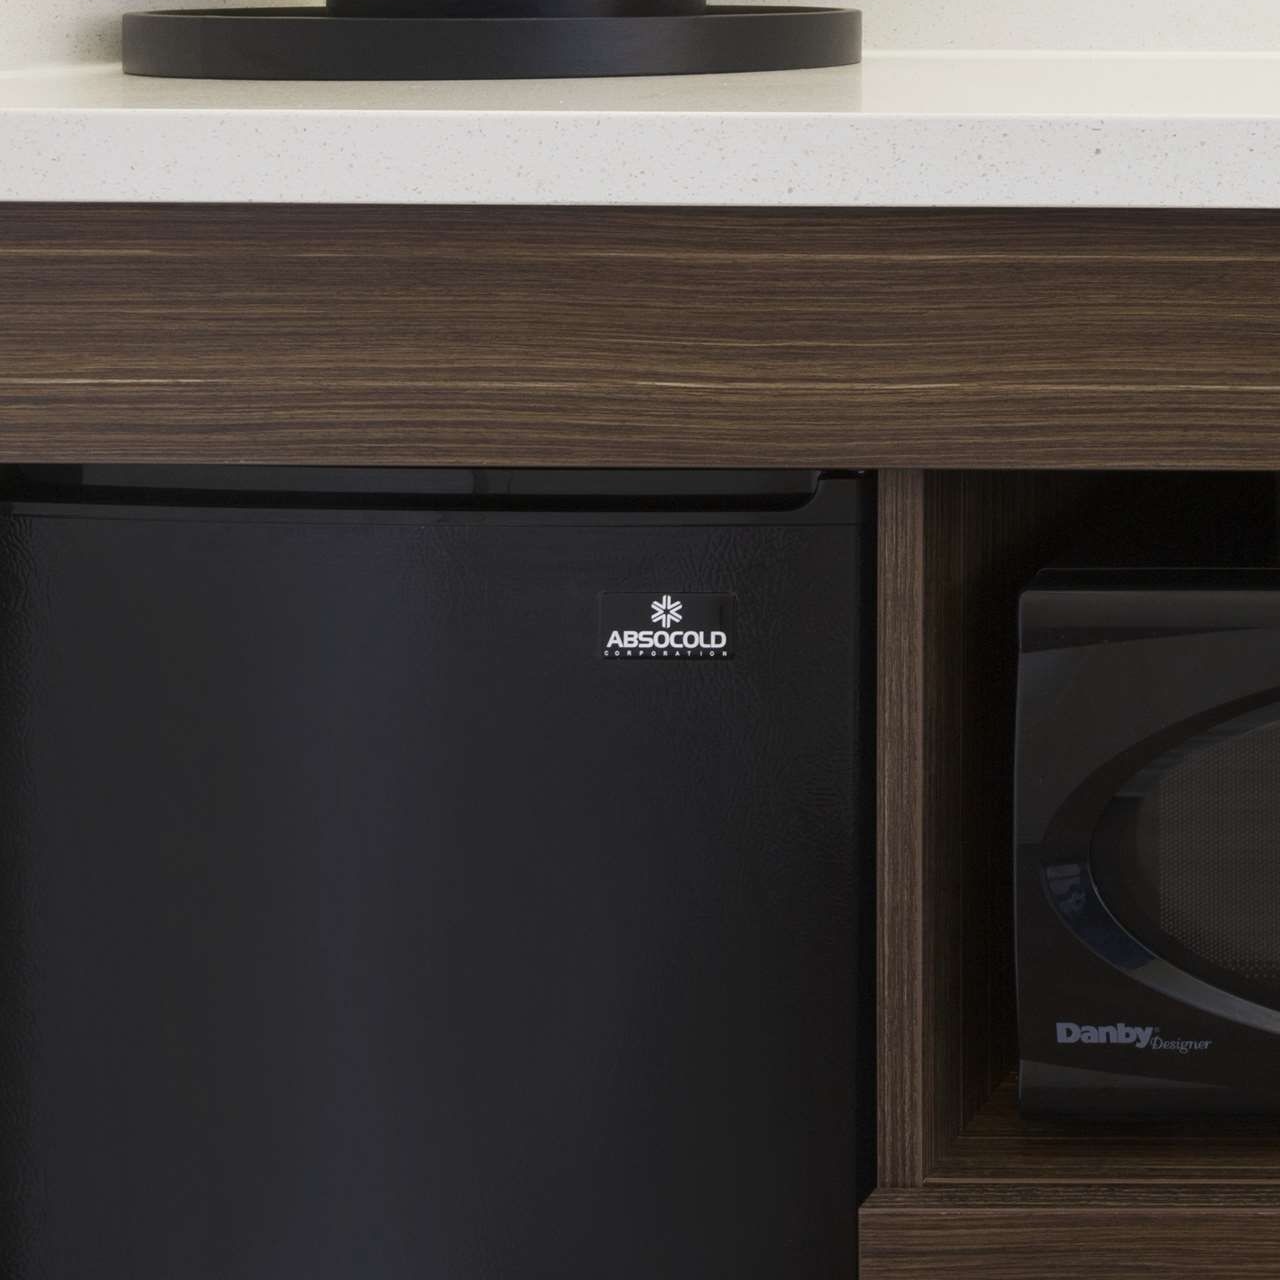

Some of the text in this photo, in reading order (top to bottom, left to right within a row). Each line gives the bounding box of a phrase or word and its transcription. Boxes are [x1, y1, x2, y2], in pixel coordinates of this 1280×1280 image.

[606, 630, 727, 649] ABSOCOLD
[1056, 1022, 1212, 1054] Danby Designer
